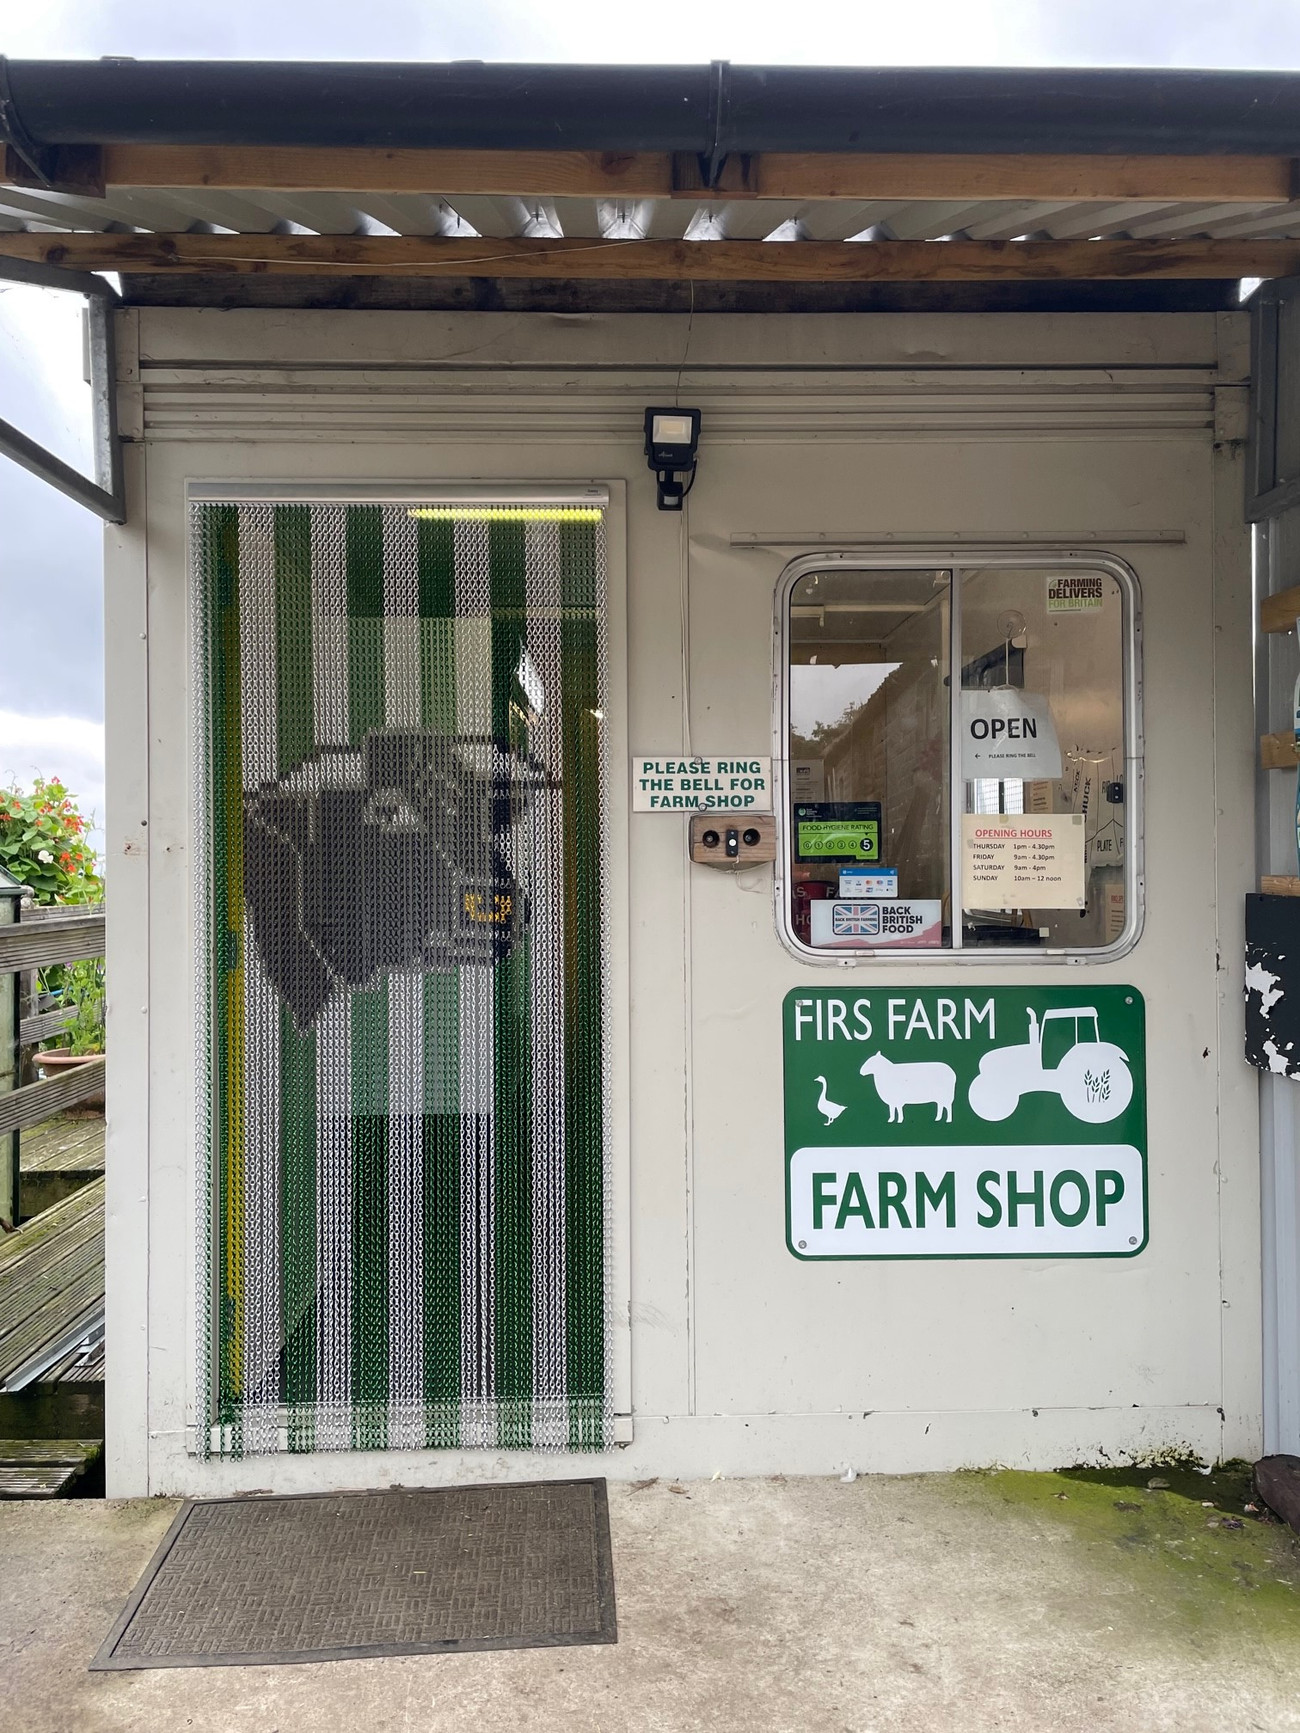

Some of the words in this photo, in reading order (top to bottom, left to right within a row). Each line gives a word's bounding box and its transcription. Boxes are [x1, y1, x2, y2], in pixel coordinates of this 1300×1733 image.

[1057, 578, 1102, 588] FARMING
[1048, 588, 1103, 599] DELIVERS
[1048, 599, 1066, 608] FOR
[1068, 598, 1103, 607] BRITAIN
[970, 718, 1037, 739] OPEN
[643, 762, 711, 774] PLEASE
[717, 762, 761, 773] RING
[639, 779, 674, 791] THE
[680, 779, 724, 790] BELL
[730, 778, 765, 790] FOR
[650, 796, 699, 807] FARM
[705, 795, 755, 807] SHOP
[975, 829, 1017, 838] OPENING
[1020, 829, 1052, 838] HOURS
[863, 840, 871, 850] 5
[1097, 840, 1113, 852] PLATE
[882, 906, 910, 915] BACK
[882, 915, 923, 924] BRITISH
[882, 925, 913, 933] FOOD
[795, 998, 872, 1040] FIRS
[888, 998, 995, 1040] FARM
[812, 1171, 956, 1229] FARM
[976, 1169, 1125, 1228] SHOP
